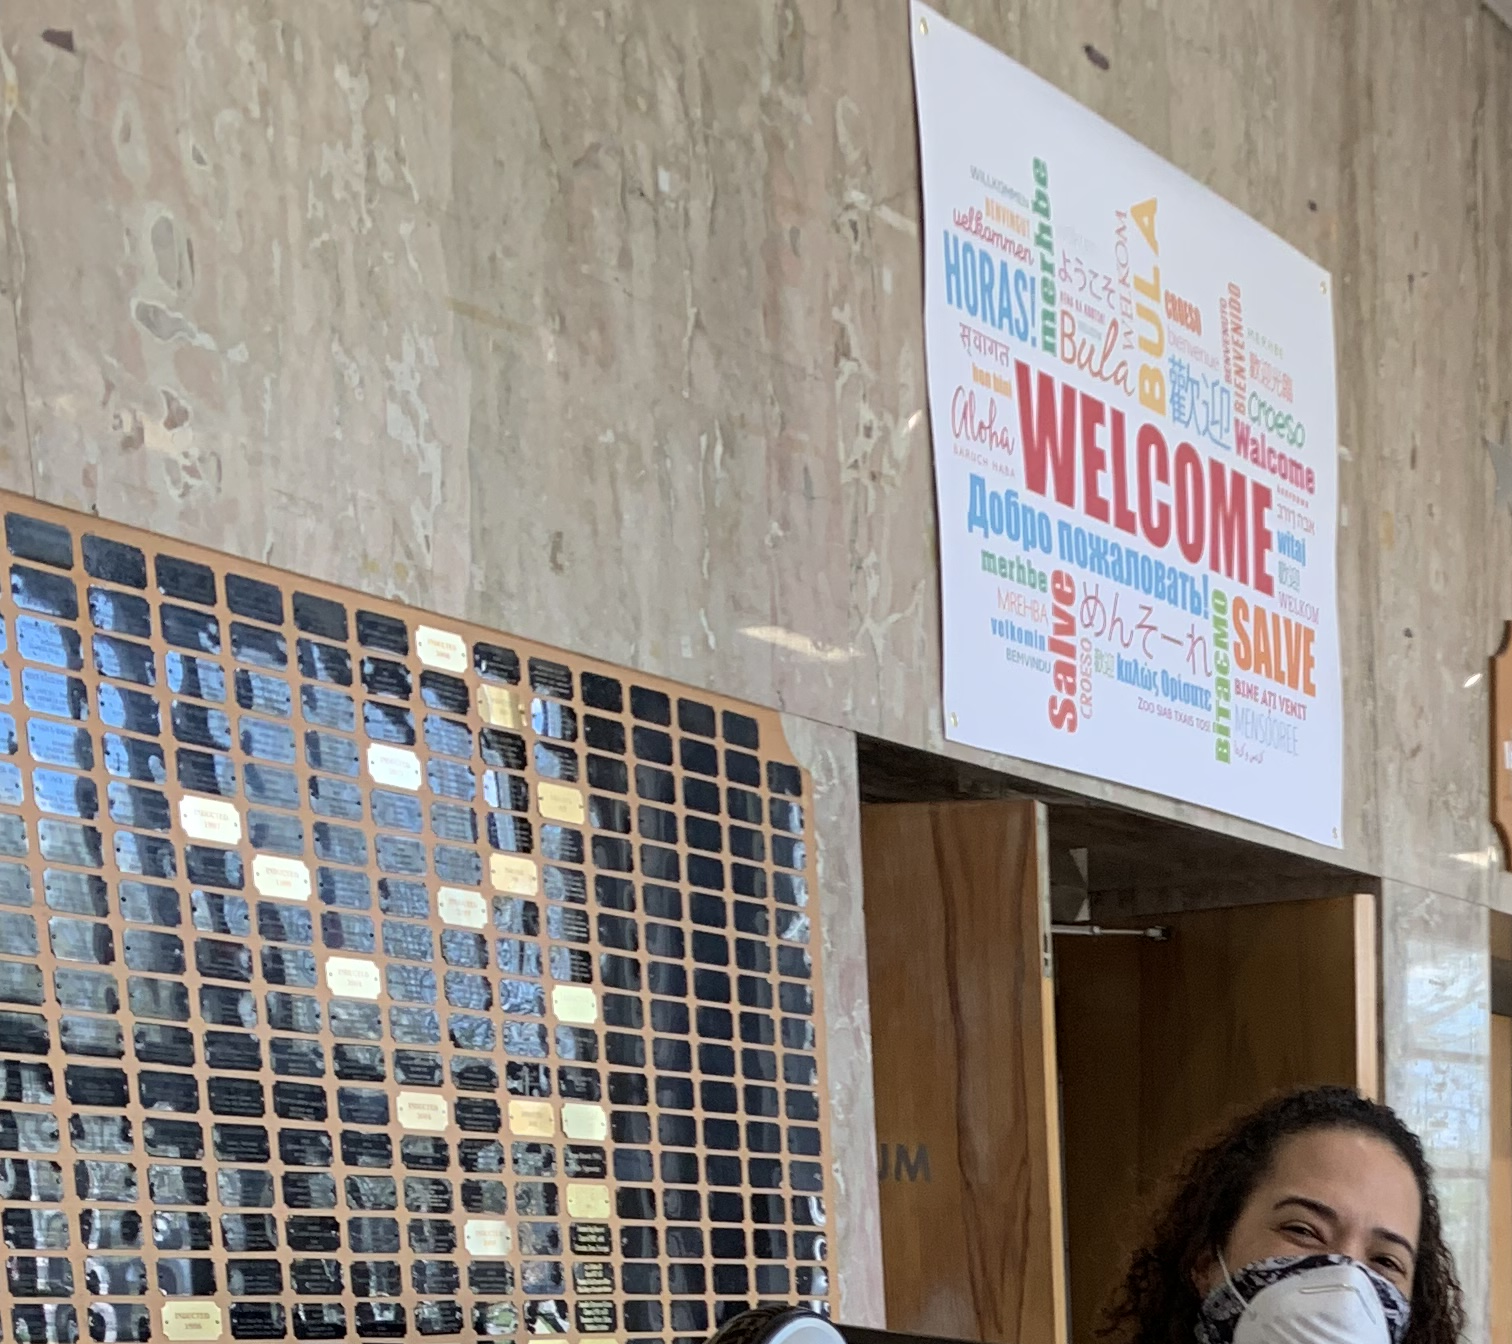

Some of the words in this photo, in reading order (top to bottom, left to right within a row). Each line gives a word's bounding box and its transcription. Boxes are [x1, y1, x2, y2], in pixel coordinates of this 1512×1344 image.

[943, 229, 1037, 348] HORAS!
[1031, 156, 1056, 357] merhbe
[1058, 248, 1115, 310] ようこそ
[1115, 209, 1134, 351] WELKOM
[1130, 196, 1167, 416] BULA
[1164, 289, 1202, 336] CROESO
[1228, 281, 1246, 416] BIENVENIDO
[1060, 308, 1135, 397] Bula
[951, 385, 1016, 456] Aloha
[1168, 353, 1232, 450] 歡迎
[1248, 391, 1305, 449] Croeso
[1014, 357, 1275, 598] WELCOME
[967, 472, 1053, 555] Добро
[1056, 518, 1209, 620] пожаловать!
[981, 549, 1048, 593] merhbe
[1277, 528, 1306, 567] witaj
[998, 586, 1049, 627] MREHBA
[1080, 581, 1212, 677] めんそーれ
[1232, 596, 1316, 698] SALVE
[1278, 591, 1320, 625] WELKOM
[1080, 637, 1093, 720] CROESO
[1138, 696, 1155, 714] ZOO
[1234, 678, 1259, 702] BINE
[1279, 695, 1307, 721] VENIT
